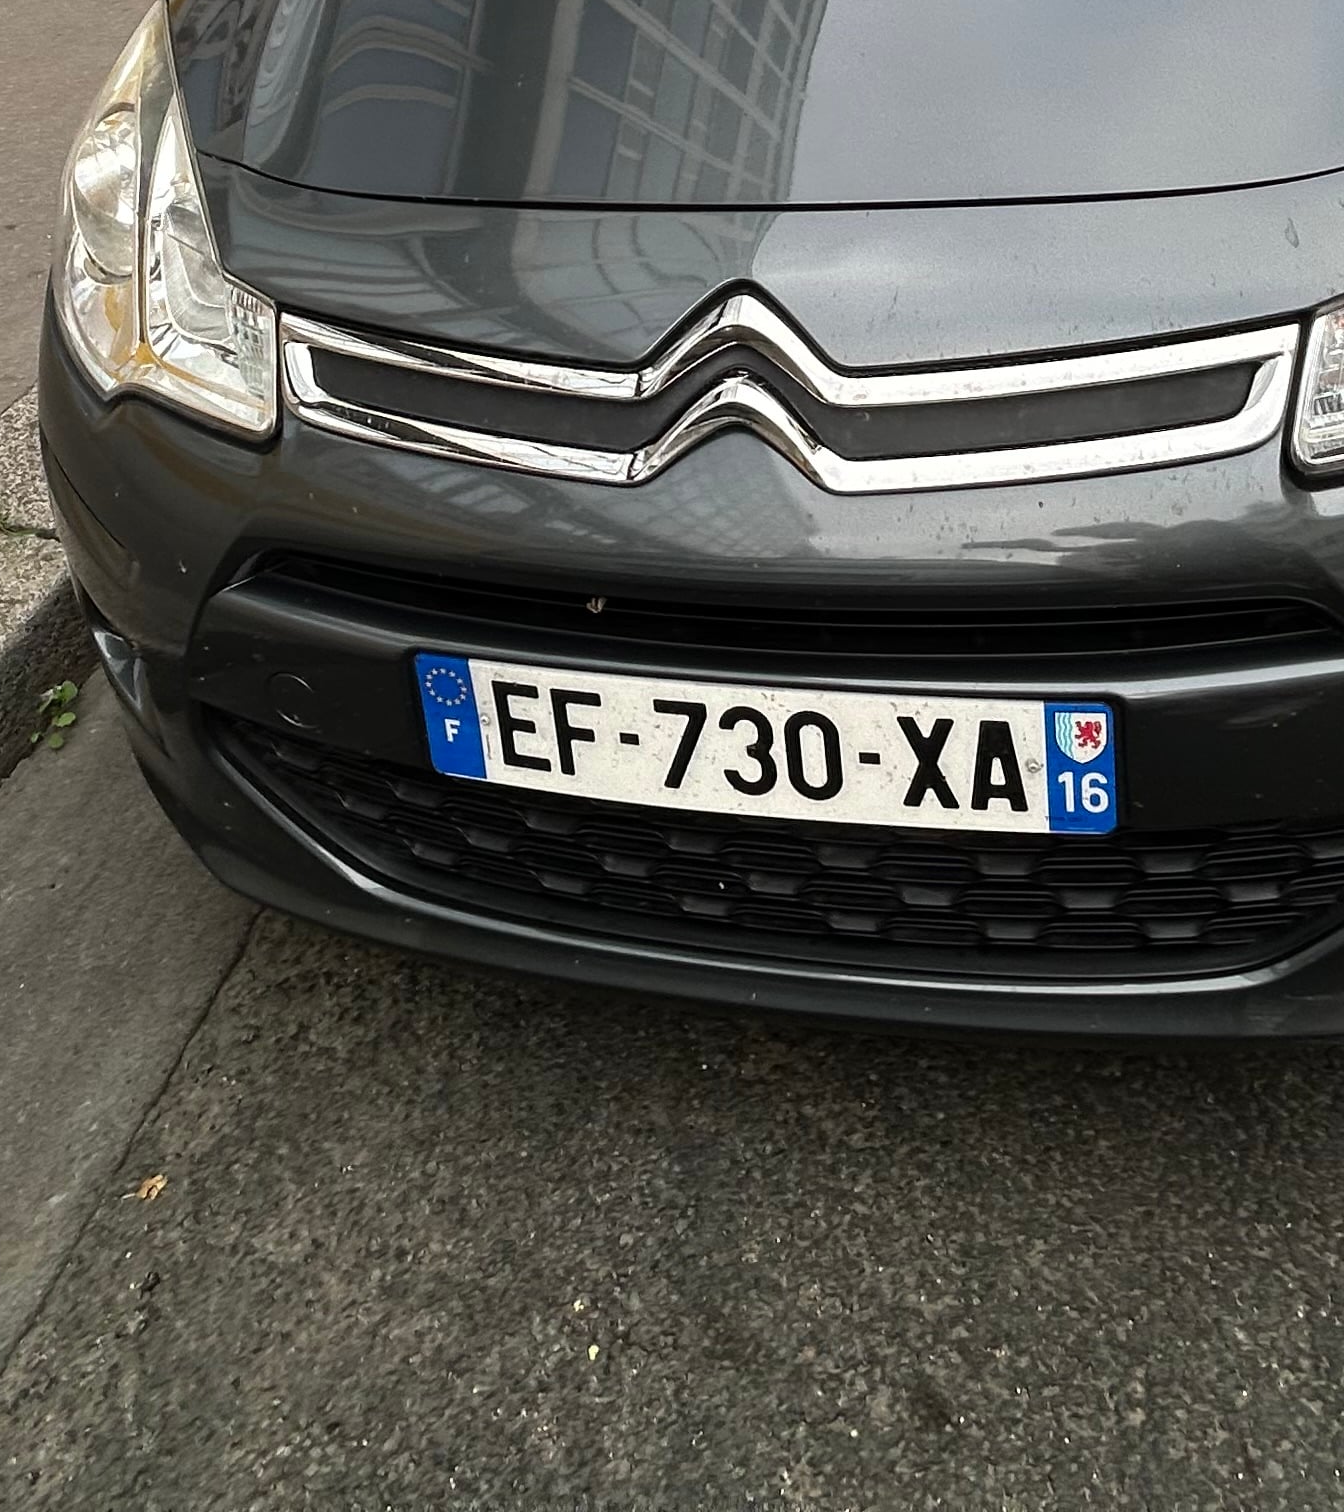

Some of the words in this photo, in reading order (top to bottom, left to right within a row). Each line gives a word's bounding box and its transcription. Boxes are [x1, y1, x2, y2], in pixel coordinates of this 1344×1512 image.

[444, 718, 461, 743] F
[491, 680, 1029, 812] EF-730-XA
[1057, 771, 1109, 814] 16
